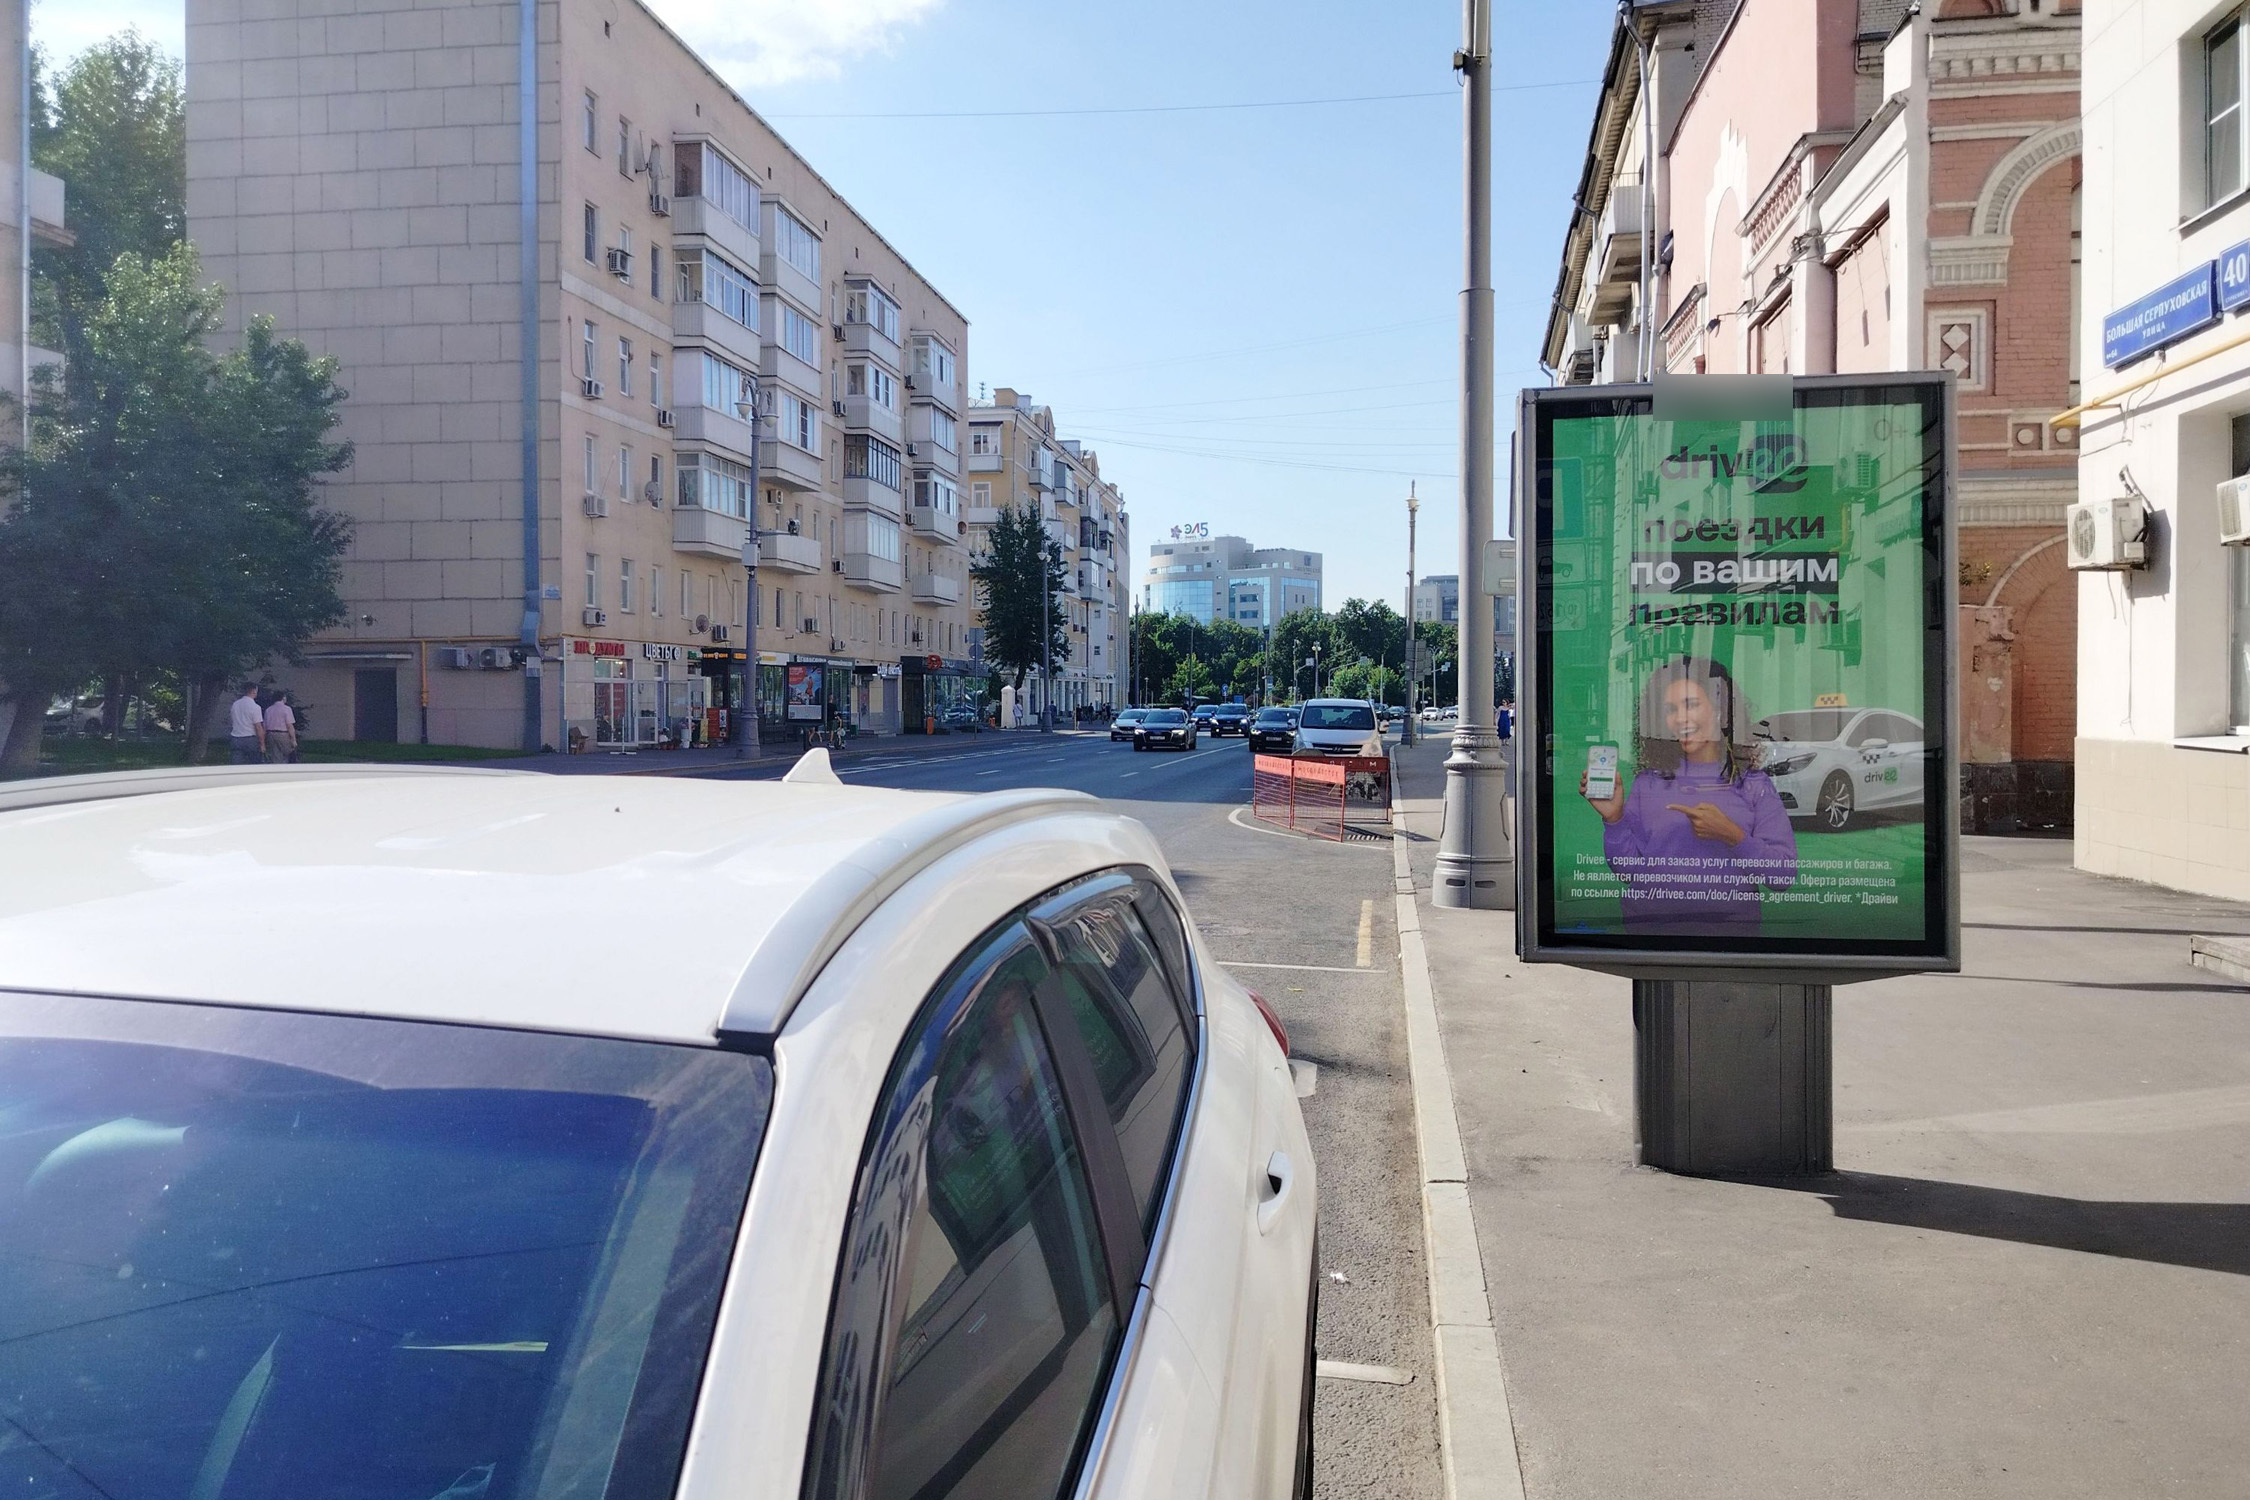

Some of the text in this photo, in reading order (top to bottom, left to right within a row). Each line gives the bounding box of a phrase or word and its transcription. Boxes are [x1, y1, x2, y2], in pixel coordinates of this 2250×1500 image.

[2223, 252, 2247, 288] 40
[2106, 279, 2208, 343] БОЛЬШАЯ СЕРПУХОВСКАЯ
[2142, 321, 2166, 339] УЛИЦА
[1644, 515, 1825, 545] поездки
[1630, 556, 1838, 585] по вашим
[1629, 601, 1840, 630] правилам
[644, 643, 673, 660] ЦВЕТЫ
[1576, 853, 1605, 865] Drivee
[1612, 857, 1646, 867] сервис
[1647, 858, 1666, 867] для
[1667, 858, 1701, 867] заказа
[1702, 858, 1729, 869] услуг
[1731, 858, 1782, 870] перевозки
[1784, 859, 1844, 871] пассажиров
[1845, 860, 1852, 868] и
[1853, 858, 1892, 870] багажа.
[1573, 870, 1896, 888] Не является перевозчиком или службой такси. Оферта размещена
[1571, 889, 1583, 898] по
[1584, 889, 1620, 898] ссылке
